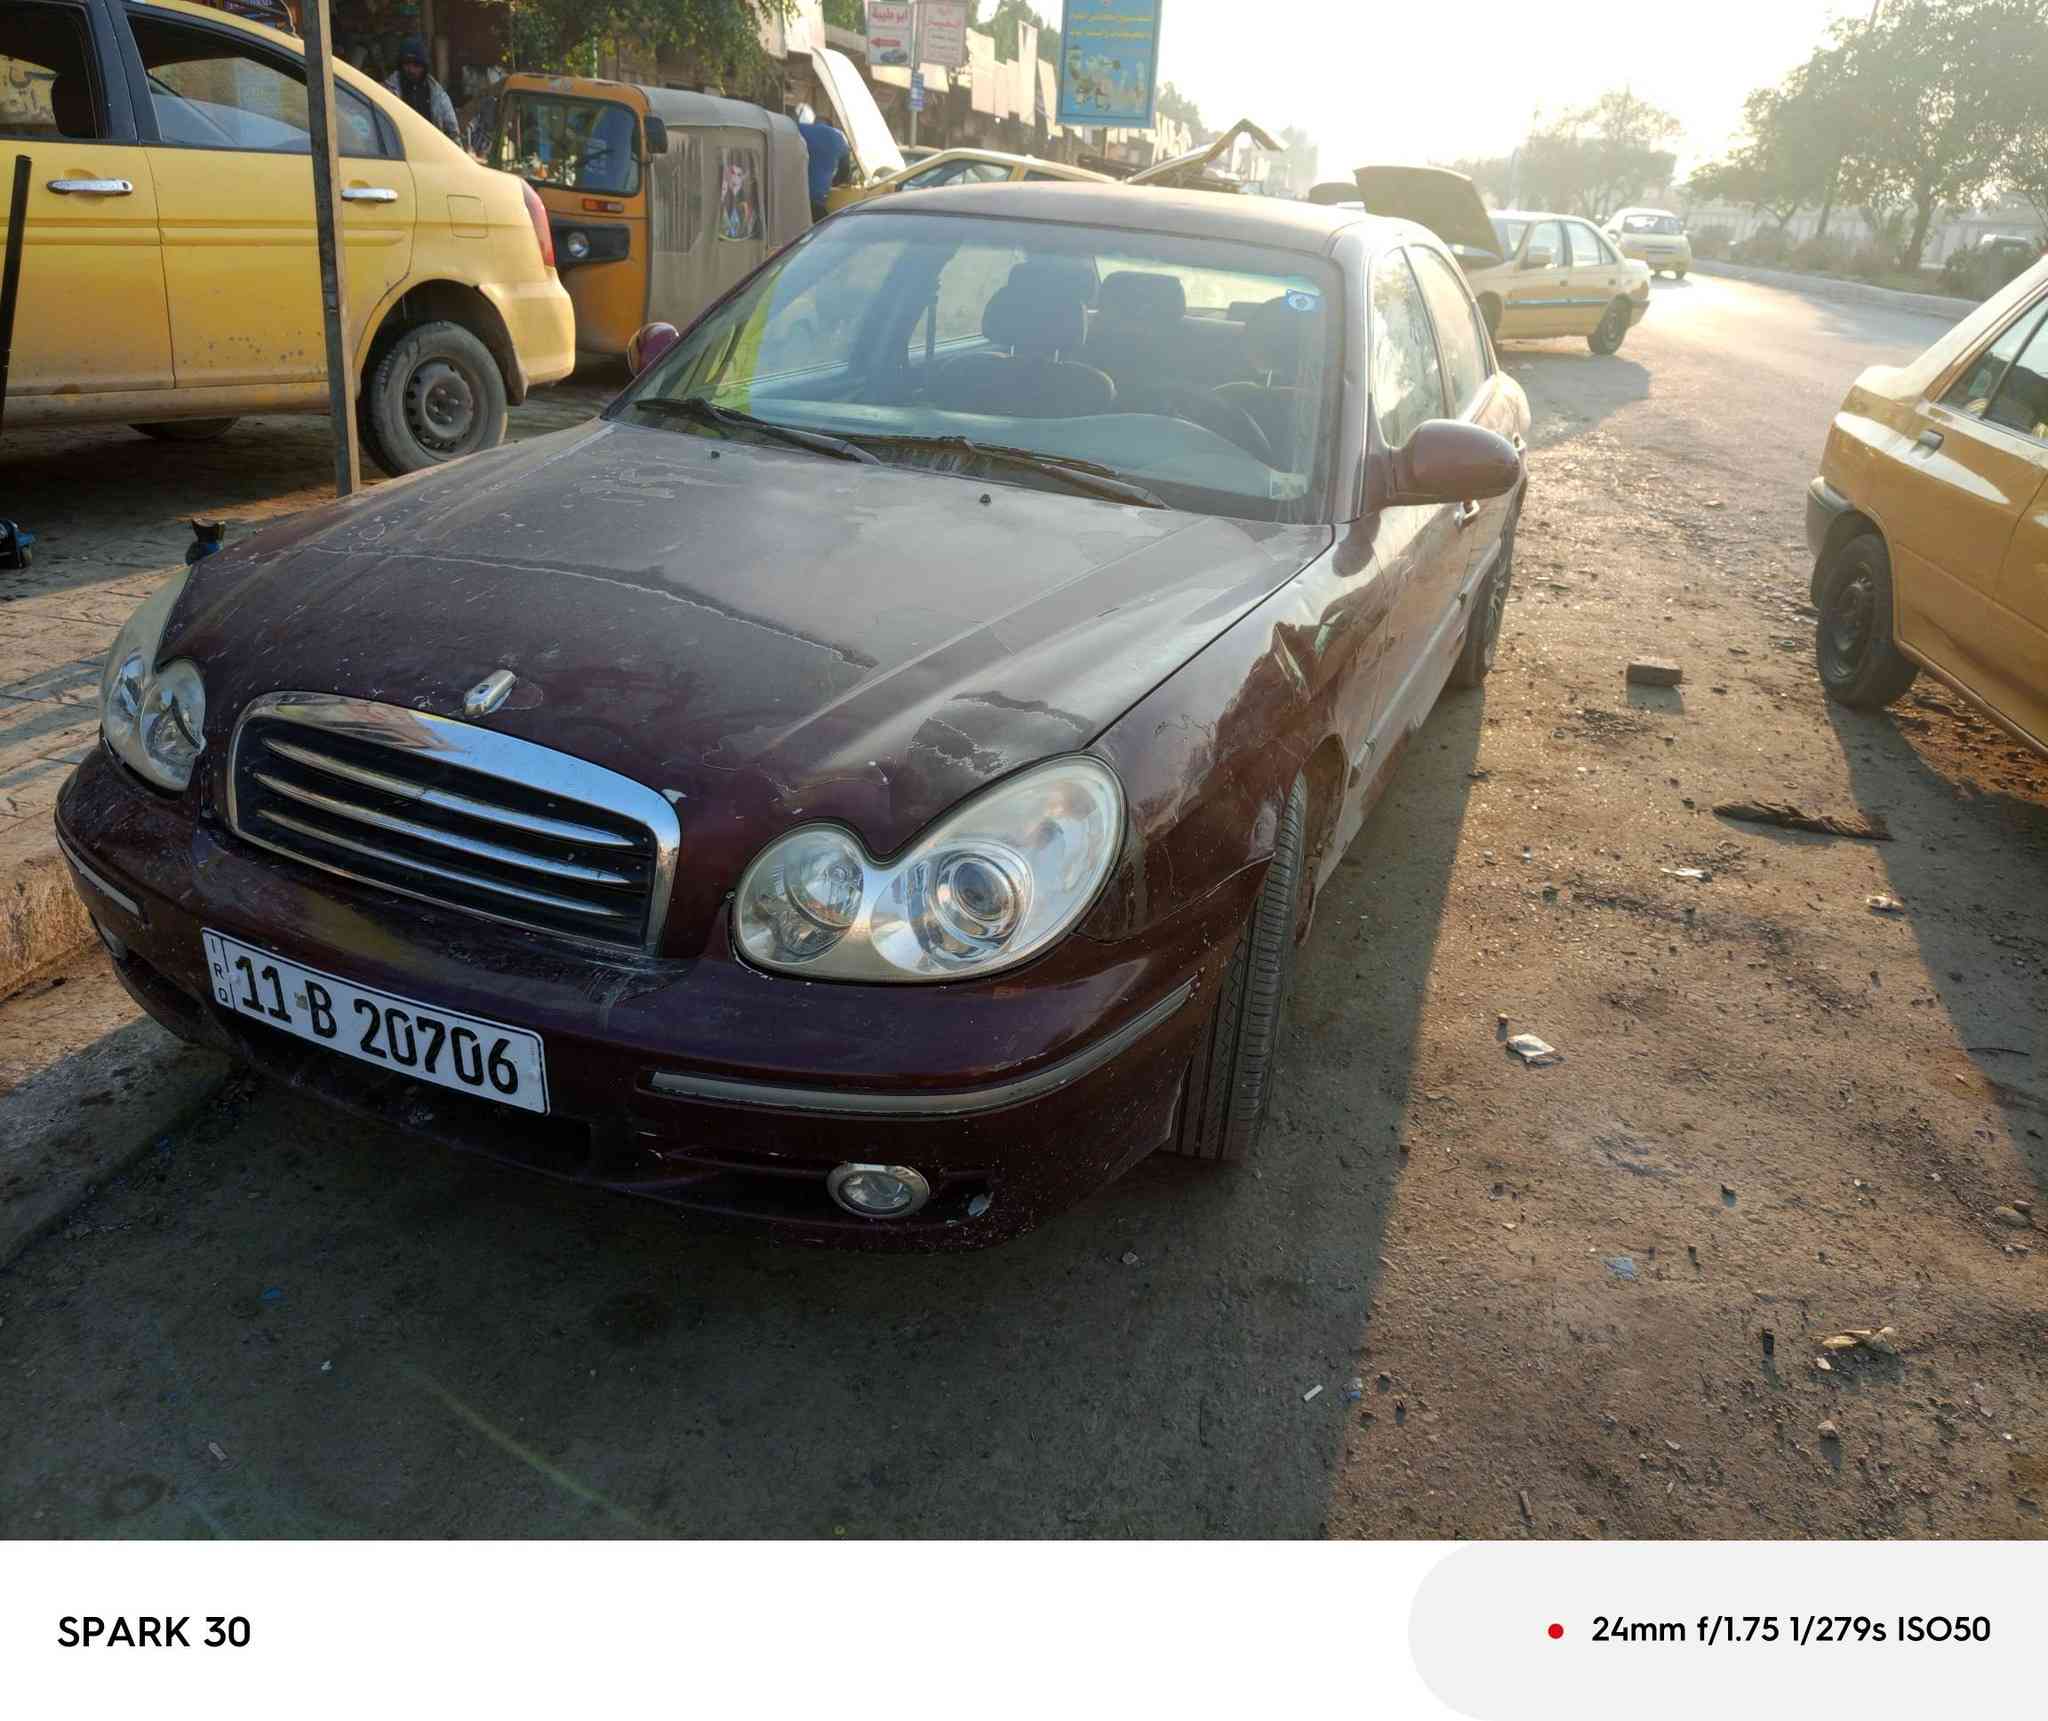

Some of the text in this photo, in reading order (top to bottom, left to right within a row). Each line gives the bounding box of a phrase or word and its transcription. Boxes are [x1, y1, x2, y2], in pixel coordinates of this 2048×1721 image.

[210, 937, 229, 1003] IRQ
[235, 955, 519, 1095] 11 B 20706
